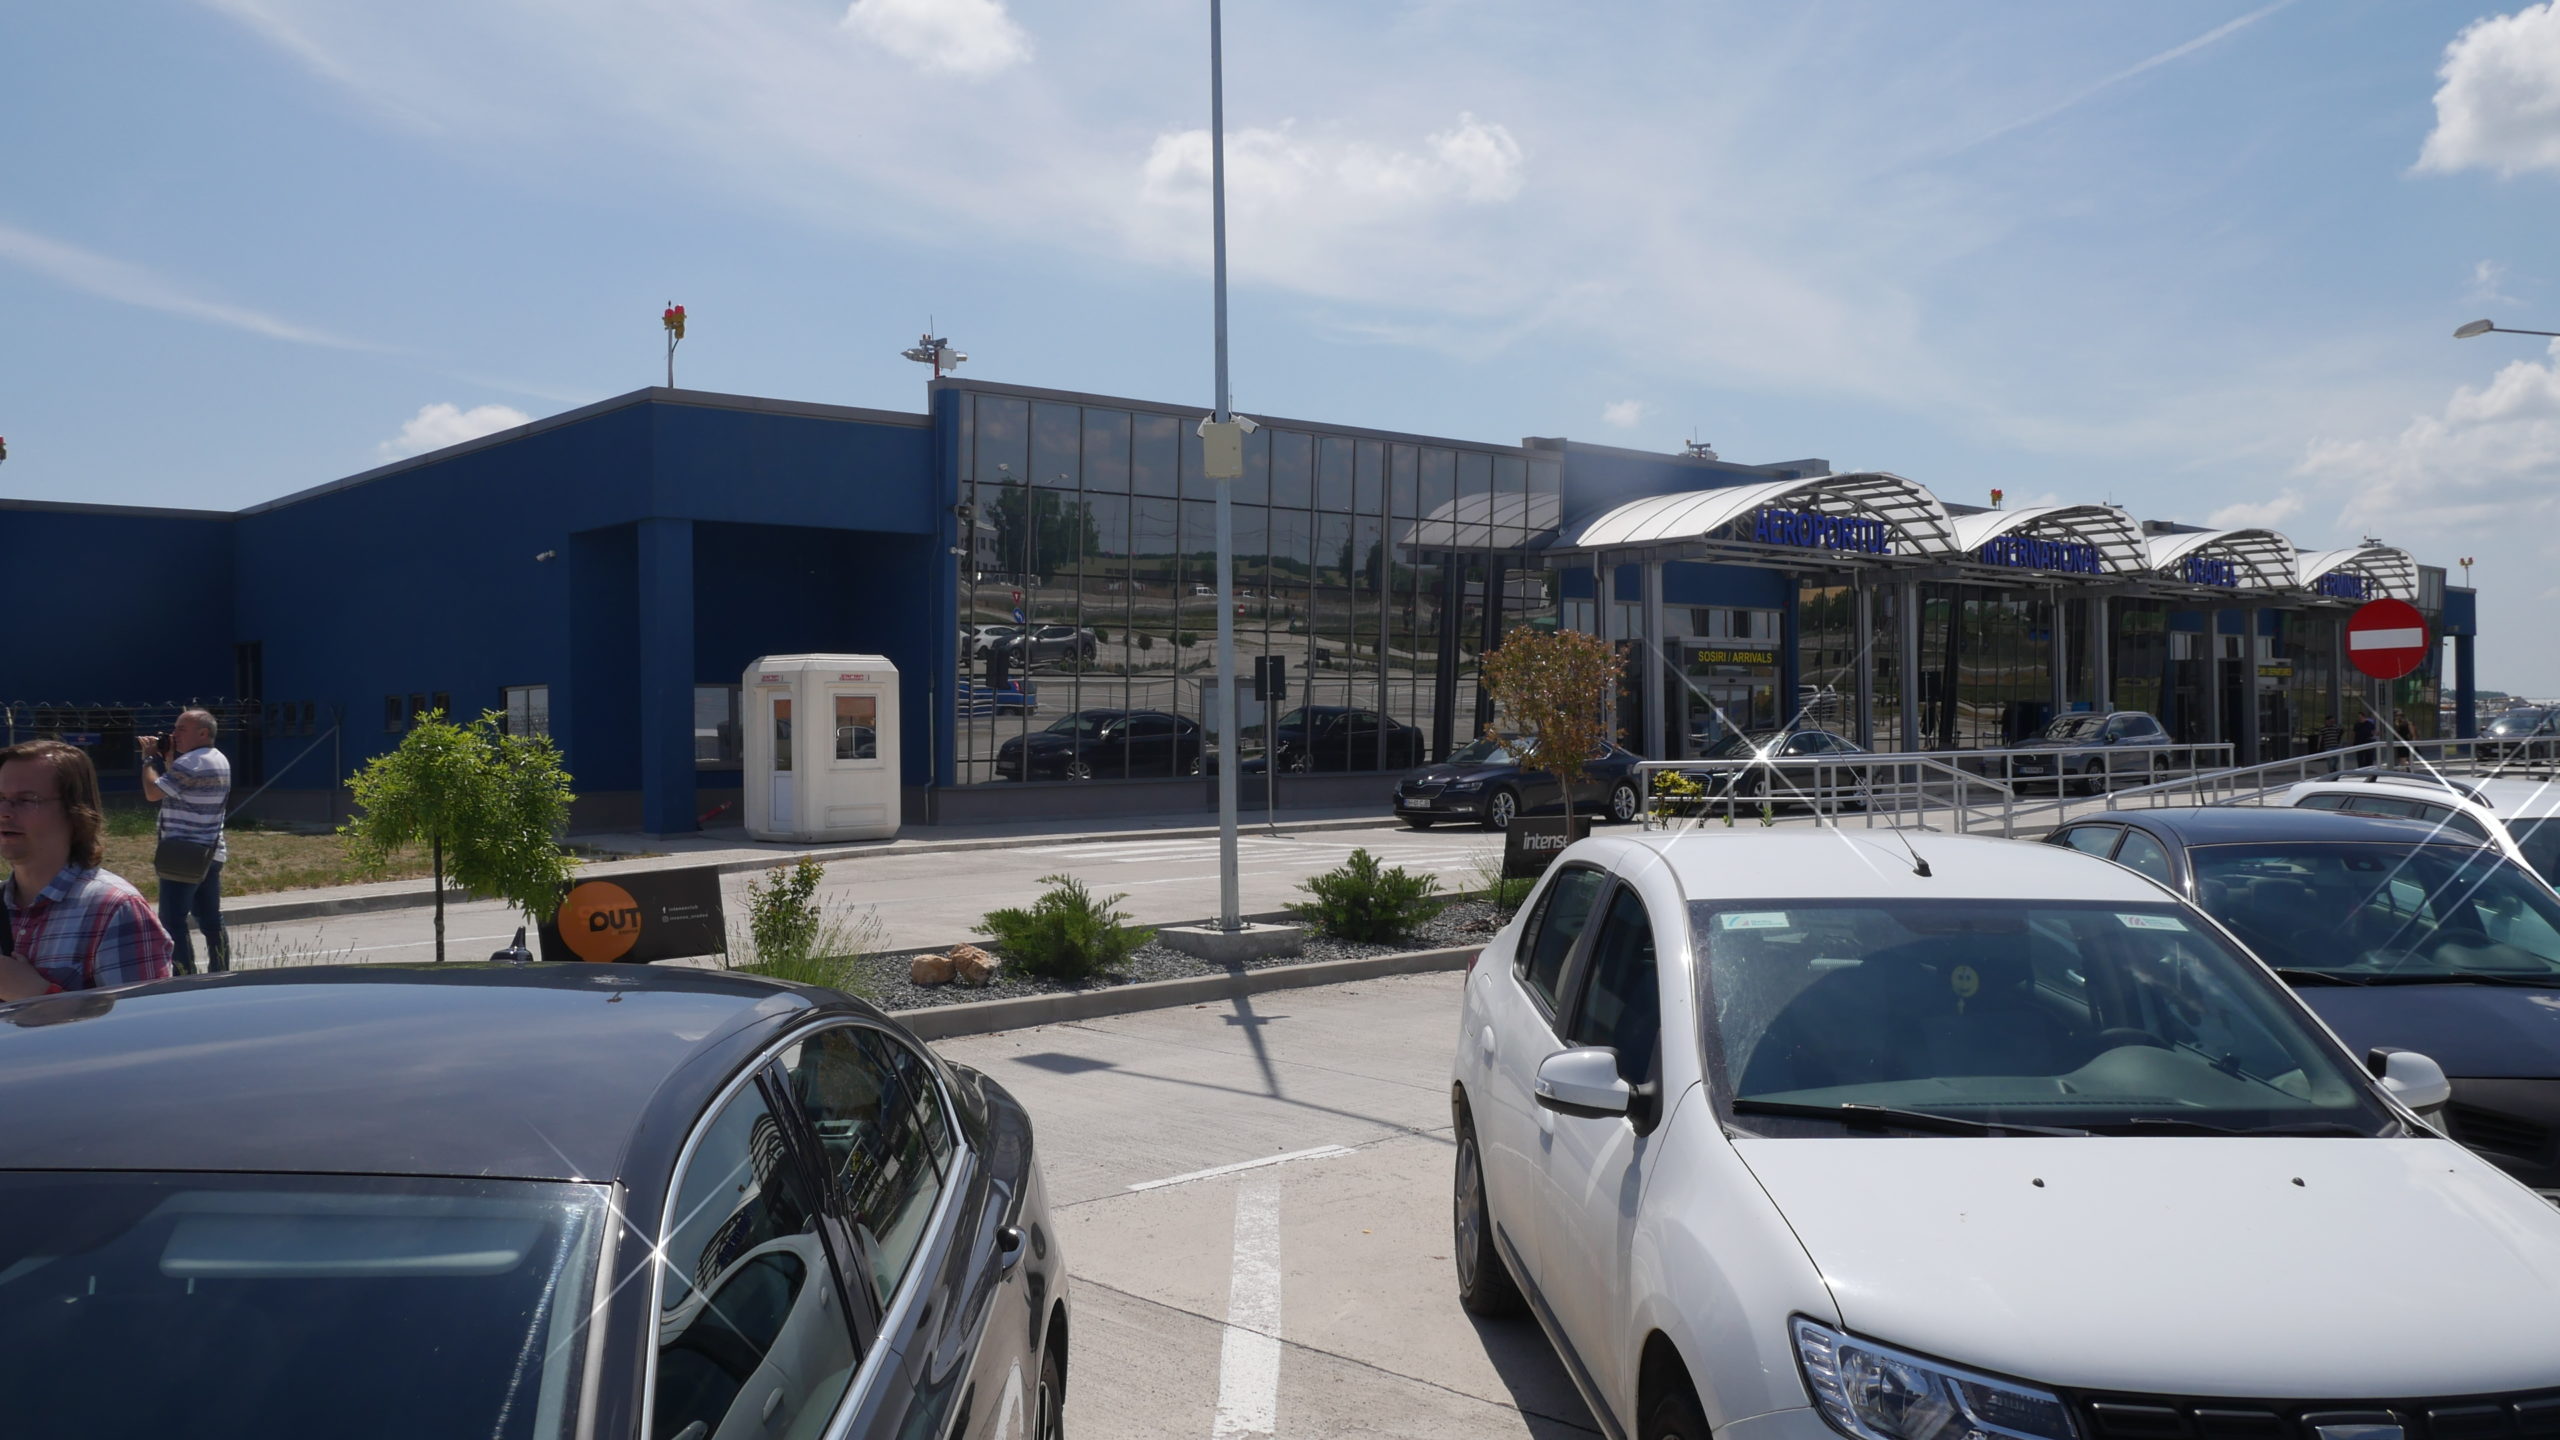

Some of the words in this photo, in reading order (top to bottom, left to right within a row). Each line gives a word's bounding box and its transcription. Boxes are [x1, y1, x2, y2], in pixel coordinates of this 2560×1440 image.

[1755, 507, 1892, 555] AEROPORTUL
[1983, 536, 2101, 575] INTERNATIONAL
[2185, 557, 2237, 587] ORADEA
[1698, 651, 1727, 663] SOSIRI
[1733, 652, 1773, 664] ARRIVALS
[590, 908, 640, 932] OUT
